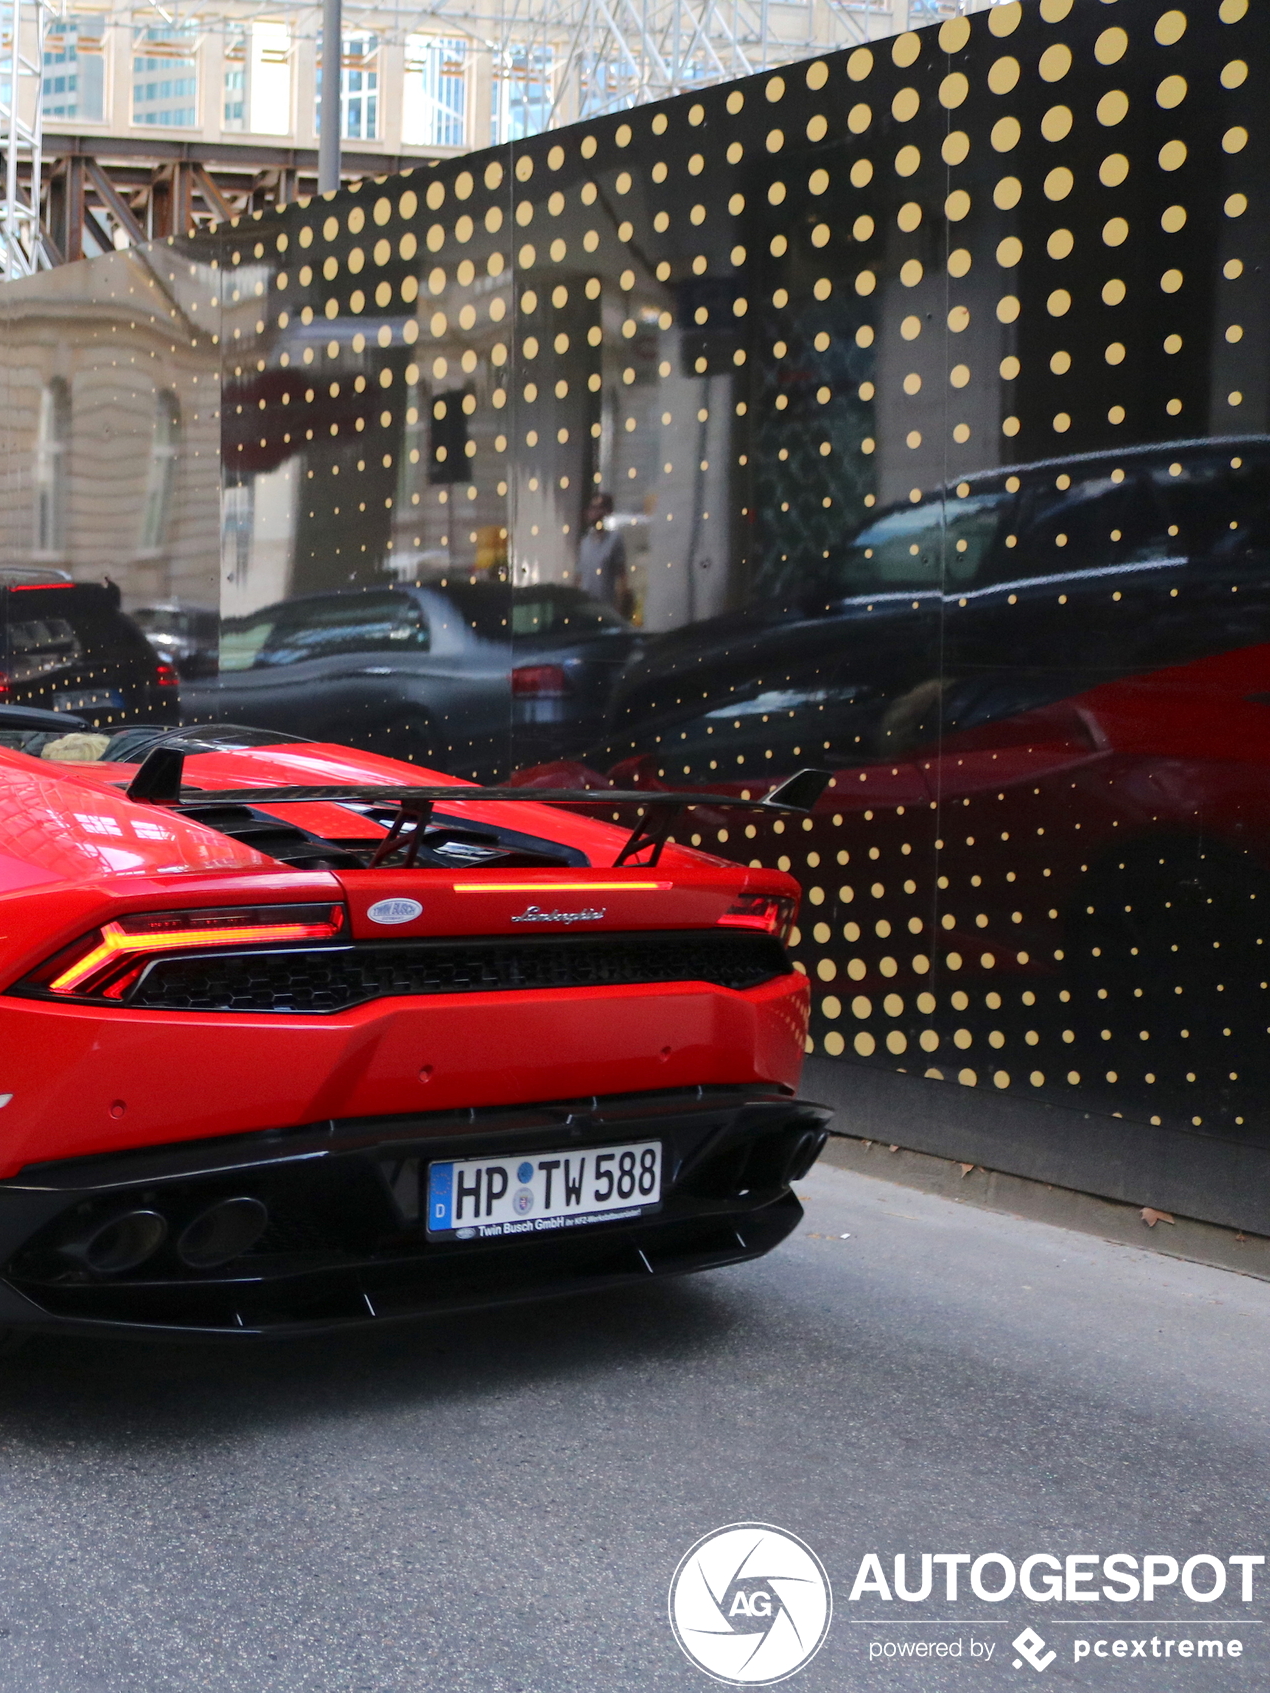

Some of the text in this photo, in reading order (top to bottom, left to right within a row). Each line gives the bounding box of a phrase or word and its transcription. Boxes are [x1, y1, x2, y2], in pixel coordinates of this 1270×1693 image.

[455, 1166, 508, 1220] HP
[435, 1203, 446, 1219] D
[478, 1224, 502, 1238] Twin
[503, 1219, 534, 1235] Busch
[534, 1216, 565, 1231] GmbH
